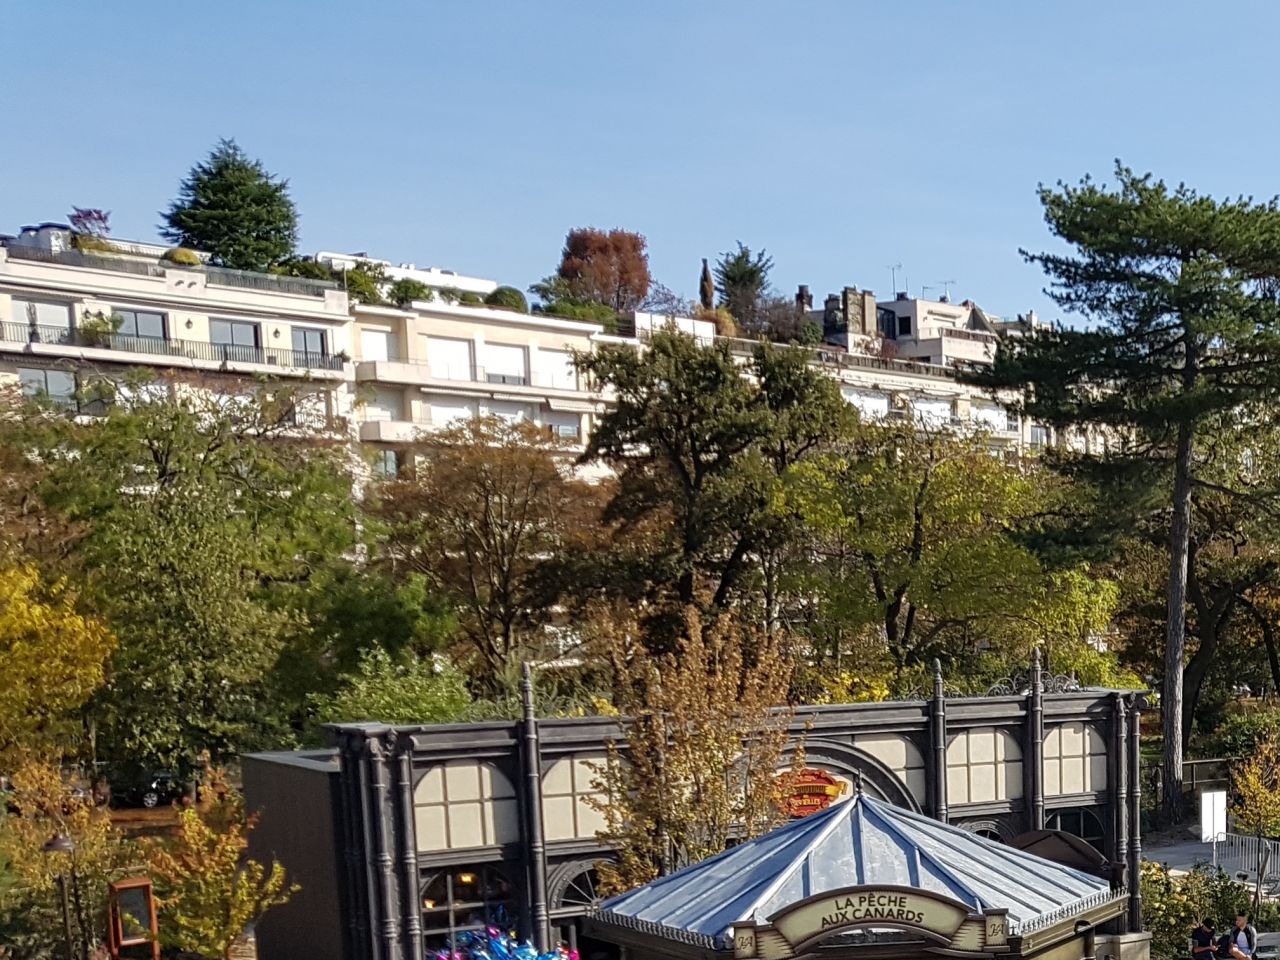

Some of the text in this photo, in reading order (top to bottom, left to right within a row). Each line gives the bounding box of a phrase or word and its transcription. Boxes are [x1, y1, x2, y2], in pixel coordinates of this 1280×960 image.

[834, 892, 907, 911] LA PÊCHE
[821, 907, 925, 929] AUX CANARDS
